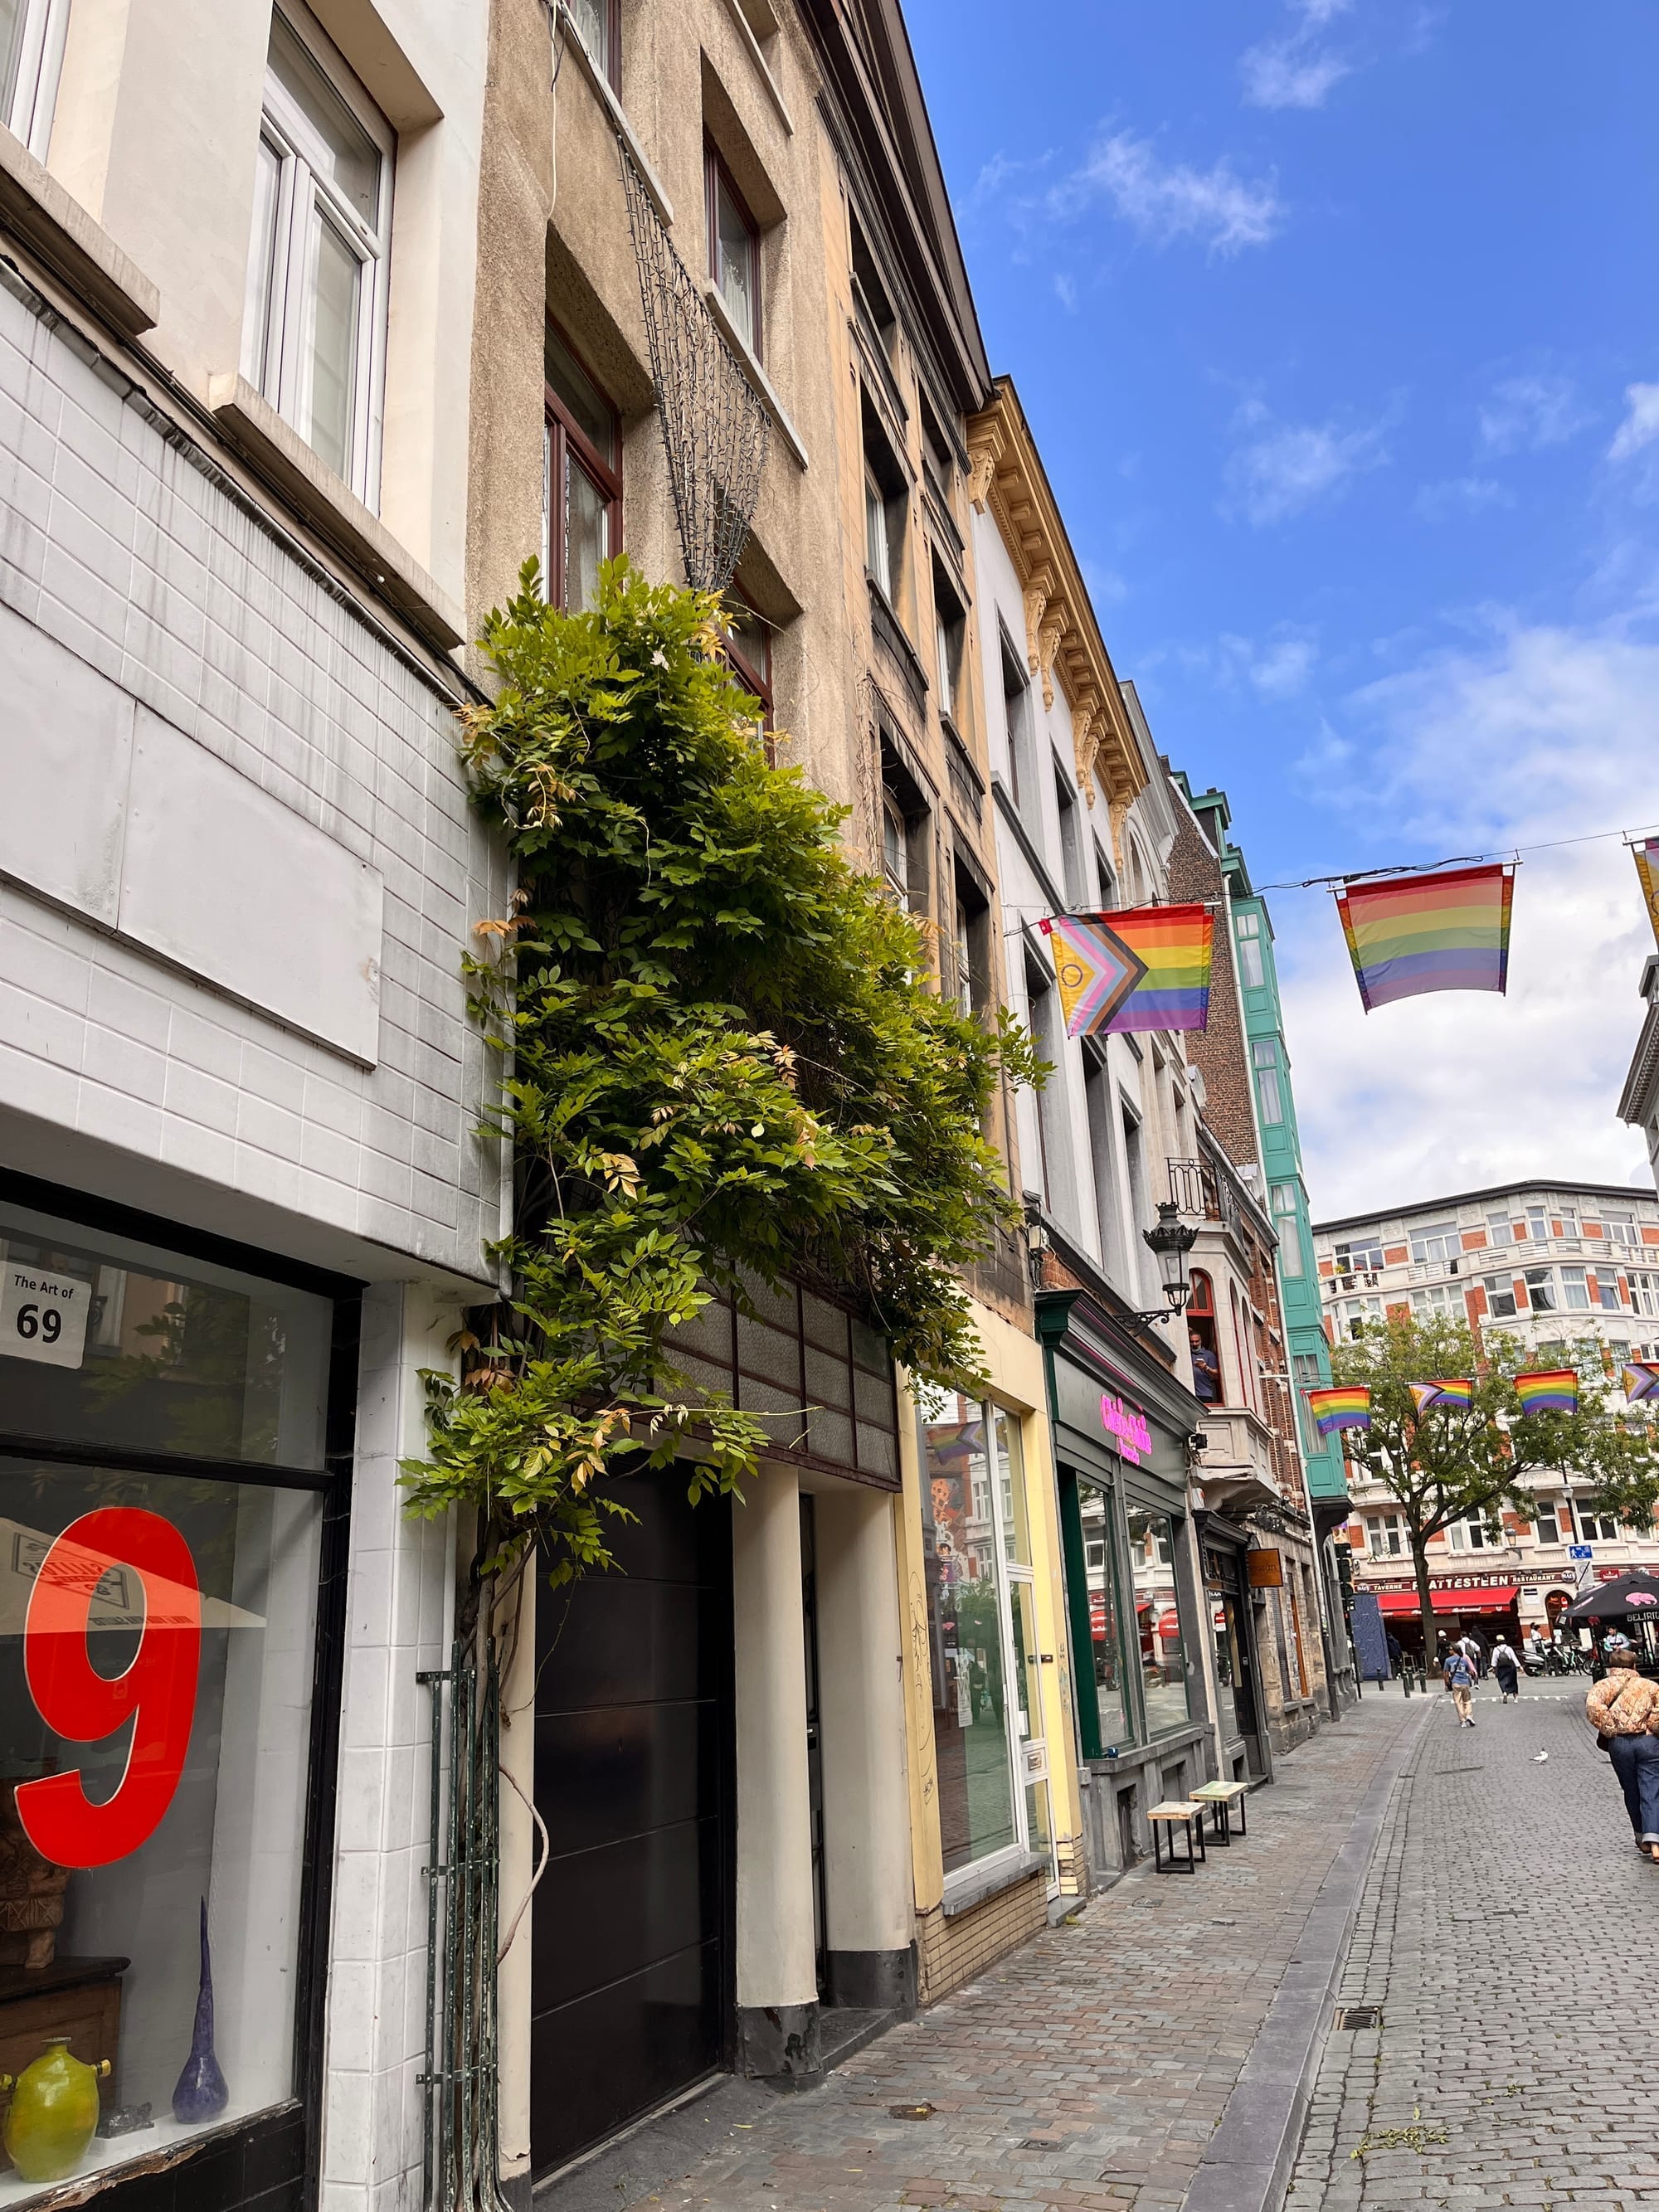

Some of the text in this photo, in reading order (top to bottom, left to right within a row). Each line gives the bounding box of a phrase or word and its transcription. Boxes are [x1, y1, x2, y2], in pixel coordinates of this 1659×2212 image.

[14, 1274, 75, 1300] The Art of
[17, 1304, 61, 1344] 69
[1412, 1575, 1509, 1591] PATTESTEEN
[1512, 1574, 1555, 1582] RESTAURANT
[14, 1506, 202, 1869] 9
